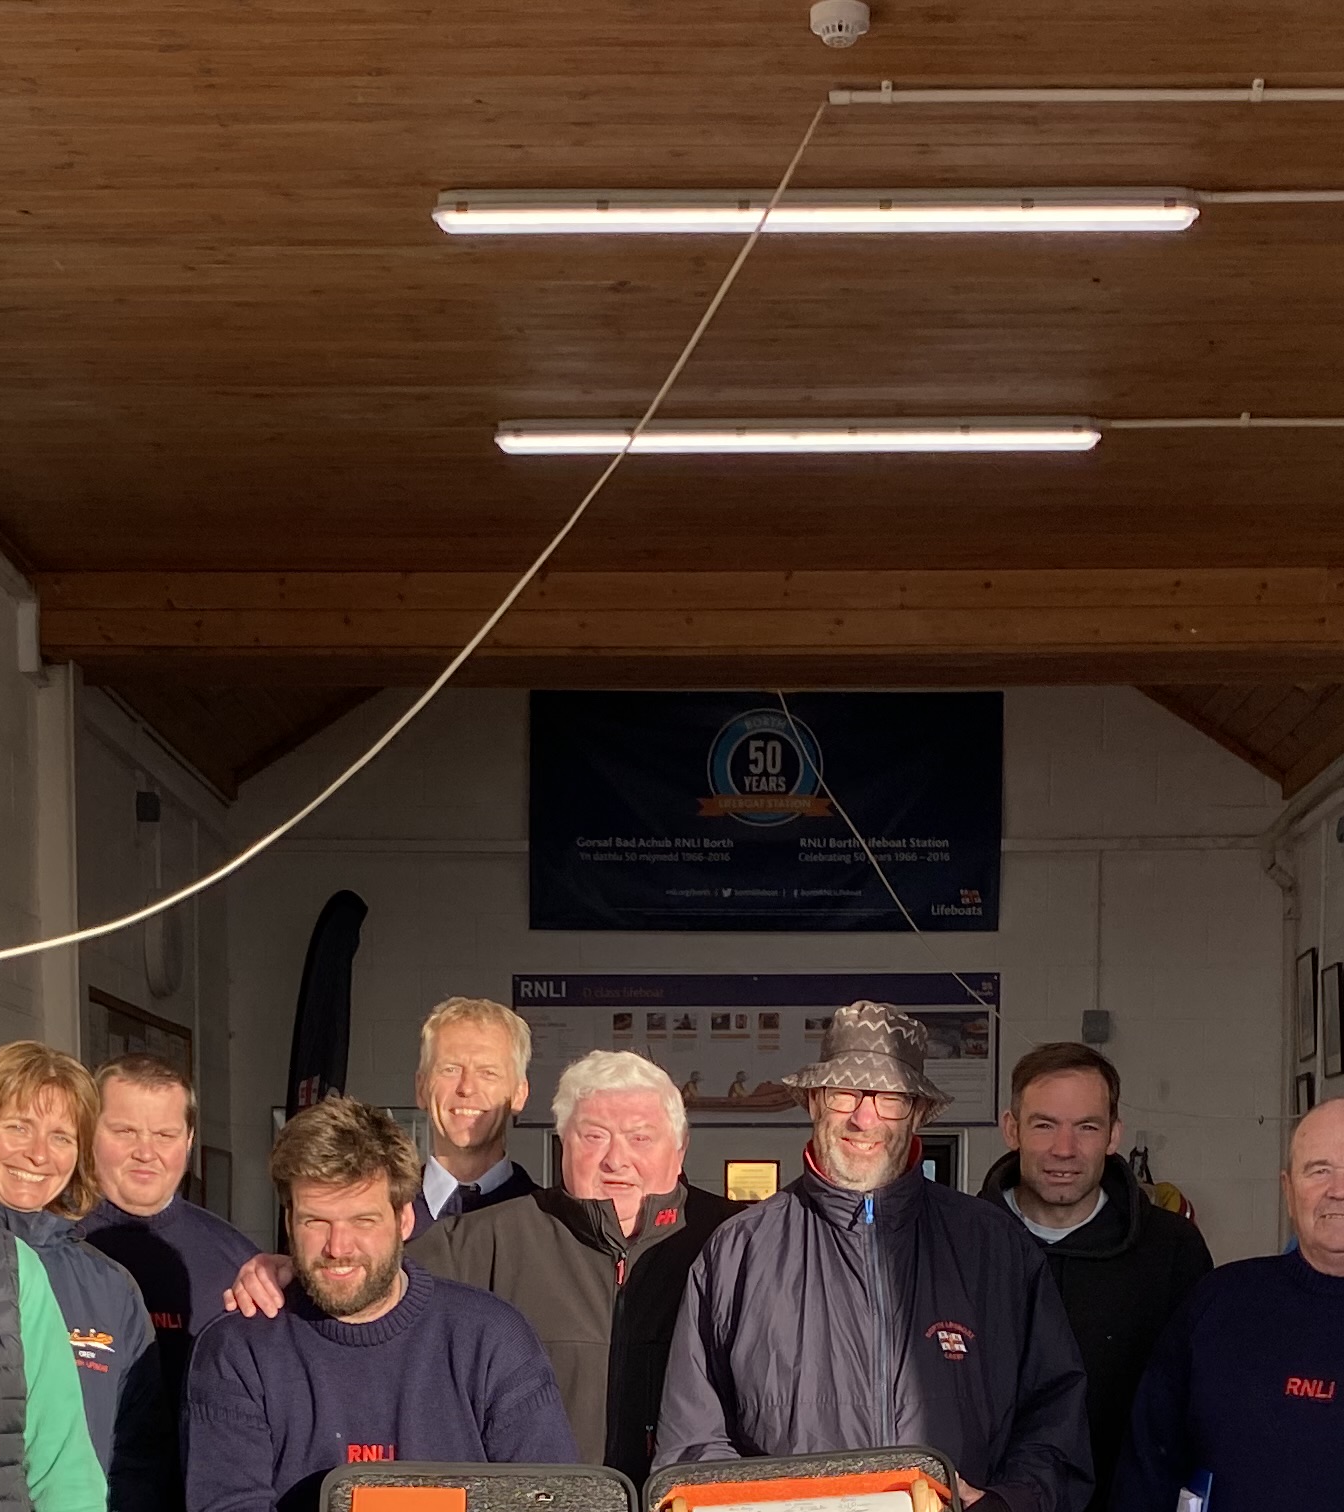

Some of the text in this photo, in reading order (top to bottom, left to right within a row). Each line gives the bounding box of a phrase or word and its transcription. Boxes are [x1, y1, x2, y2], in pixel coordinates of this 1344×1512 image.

[748, 740, 782, 774] 50
[744, 776, 786, 793] YEARS
[767, 798, 812, 809] STATION
[576, 836, 734, 848] Gorsaf Bad Achub RNLI Borth
[799, 837, 827, 848] RNLI
[829, 837, 860, 848] Borth
[909, 837, 950, 848] Station
[625, 852, 637, 862] 50
[798, 852, 852, 865] Celebrating
[853, 852, 865, 862] 50
[895, 852, 918, 863] 1966
[926, 852, 950, 863] 2016
[931, 903, 983, 916] Lifeboats
[520, 980, 566, 998] RNLI
[150, 1312, 183, 1329] NLI
[1285, 1377, 1336, 1399] RNLI
[347, 1444, 395, 1463] RNLI
